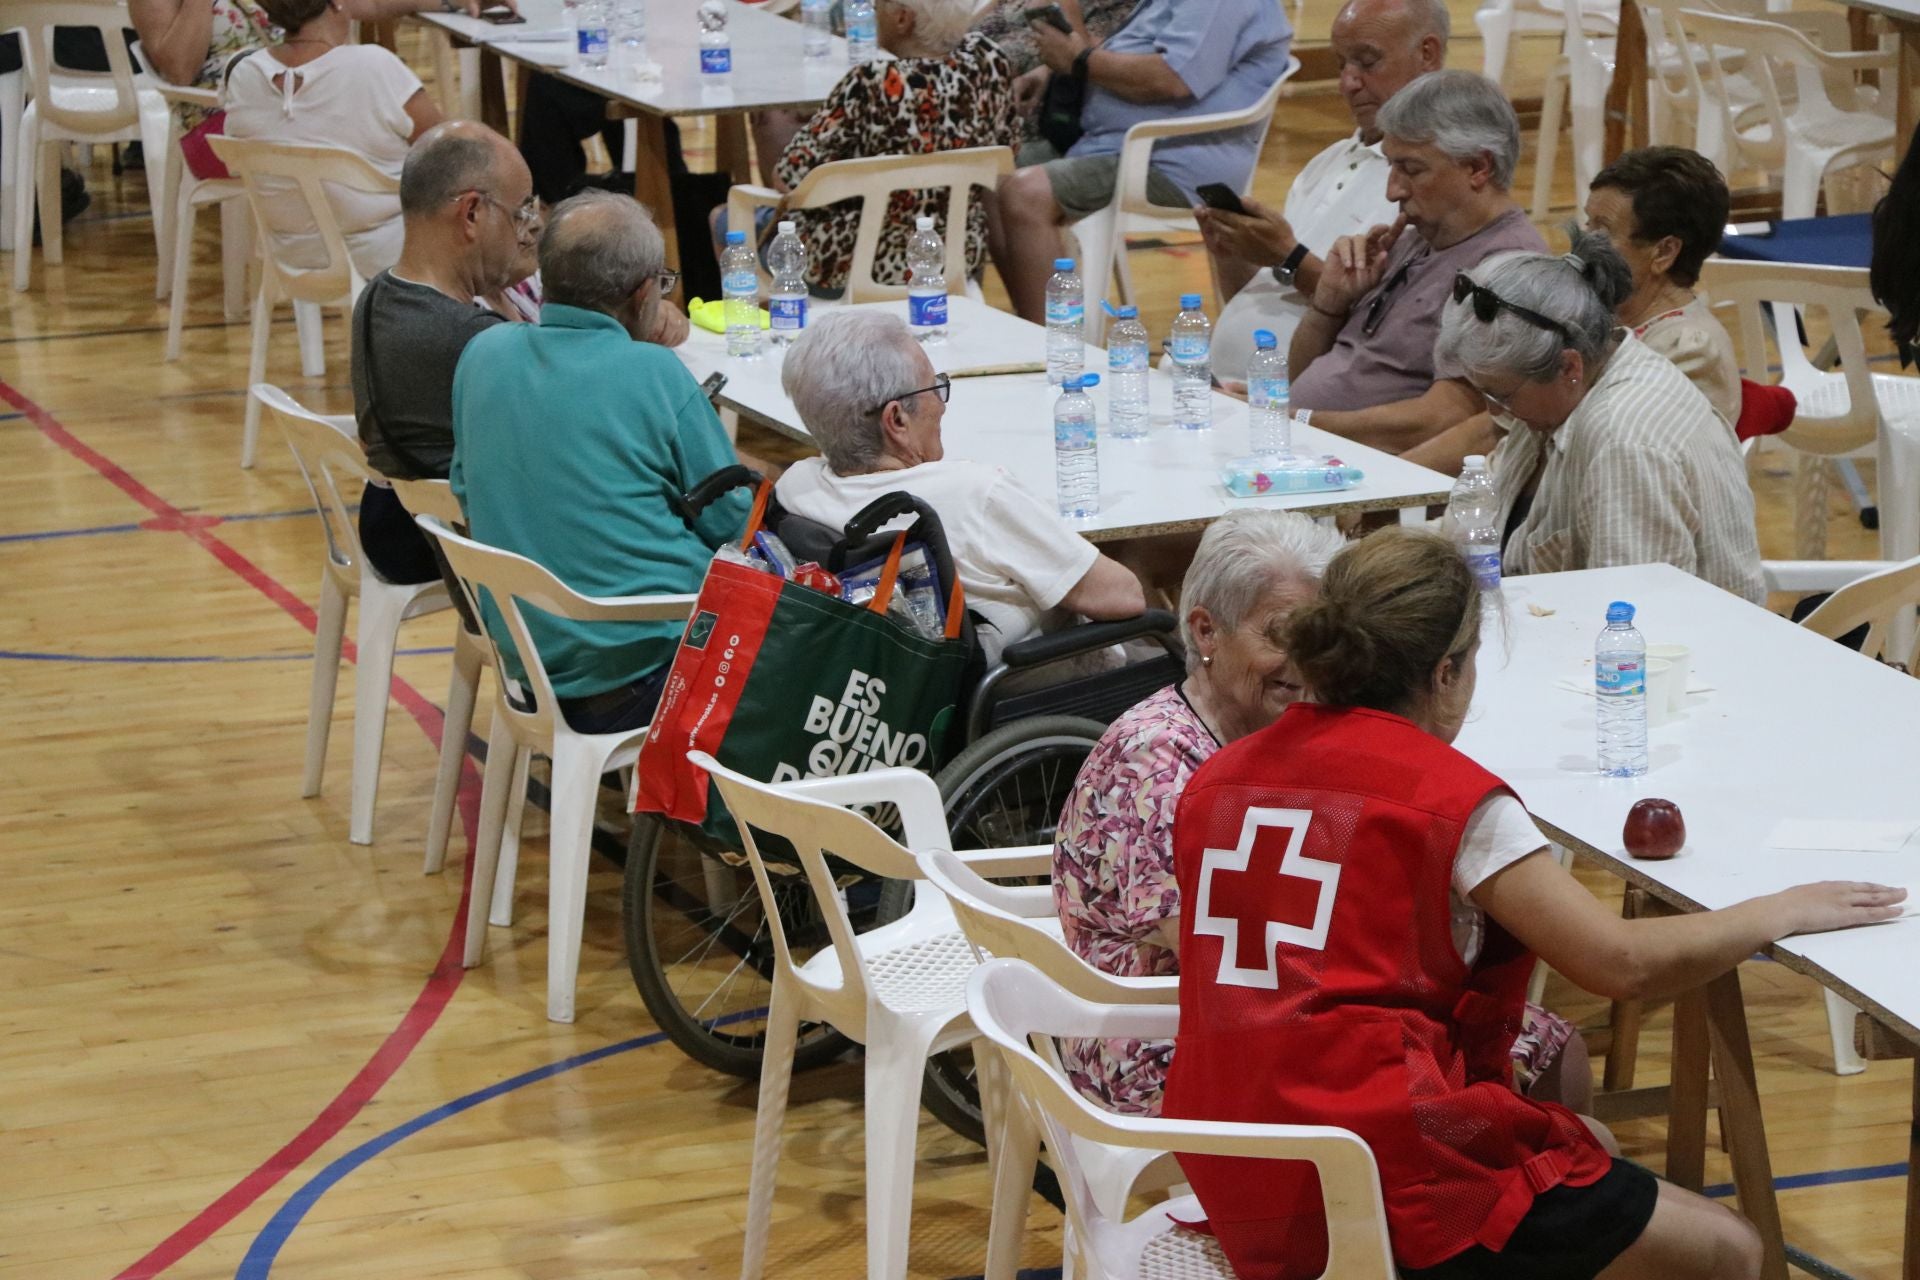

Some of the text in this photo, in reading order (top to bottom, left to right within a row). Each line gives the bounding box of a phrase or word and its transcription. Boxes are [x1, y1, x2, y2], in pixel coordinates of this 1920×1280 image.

[688, 692, 719, 747] www.eroski.es
[840, 668, 887, 716] ES
[803, 694, 927, 768] BUENO
